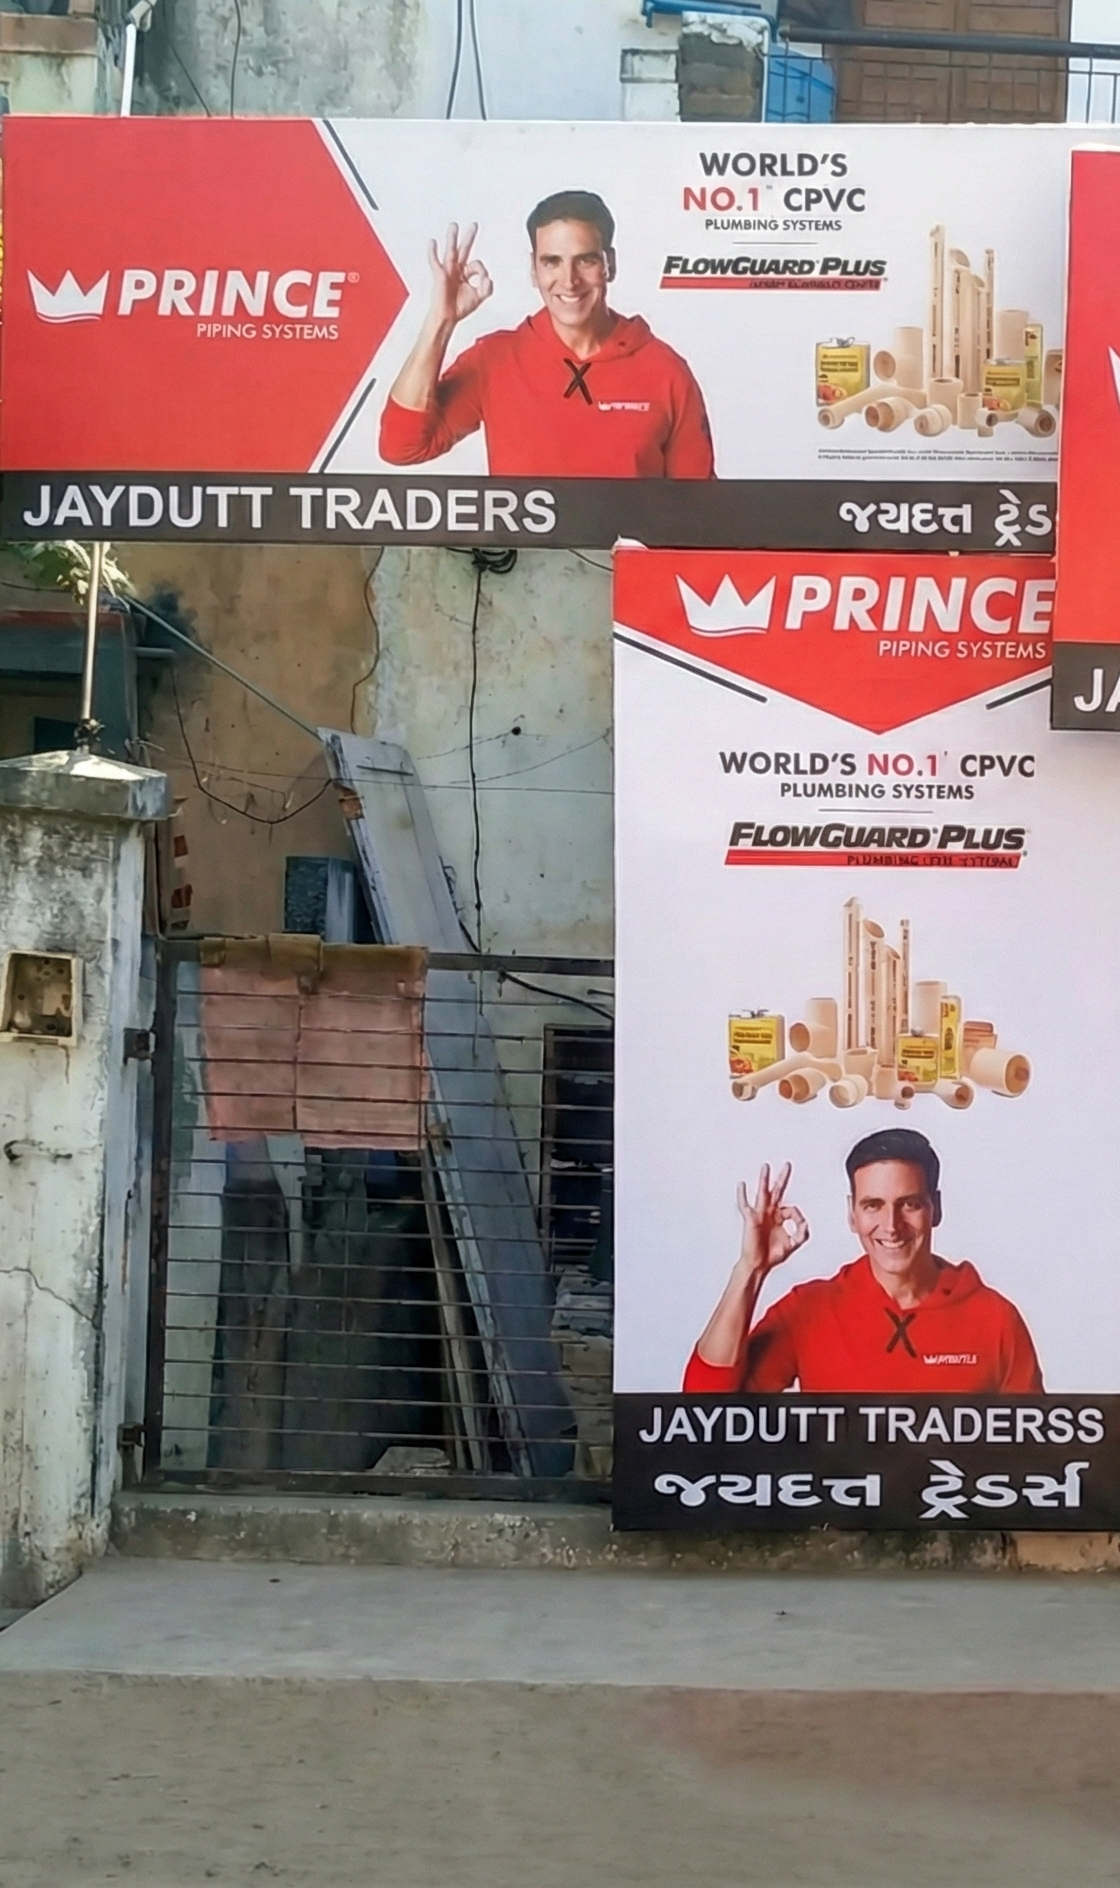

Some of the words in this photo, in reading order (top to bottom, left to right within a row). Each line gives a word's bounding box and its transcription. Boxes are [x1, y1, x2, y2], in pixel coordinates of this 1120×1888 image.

[699, 152, 848, 177] WORLD'S
[783, 187, 866, 212] CPVC
[705, 219, 779, 231] PLUMBING
[782, 220, 842, 231] SYSTEMS
[117, 269, 346, 318] PRINCE
[197, 323, 257, 339] PIPING
[262, 324, 339, 340] SYSTEMS
[23, 484, 273, 528] JAYDUTT
[290, 487, 557, 533] TRADERS
[784, 575, 1055, 634] PRINCE
[879, 641, 950, 658] PIPING
[956, 641, 1046, 659] SYSTEMS
[719, 752, 857, 776] WORLD'S
[960, 755, 1035, 777] CPVC
[781, 783, 885, 798] PLUMBING
[892, 784, 974, 800] SYSTEMS
[638, 1407, 845, 1443] JAYDUTT
[859, 1407, 1104, 1444] TRADERSS
